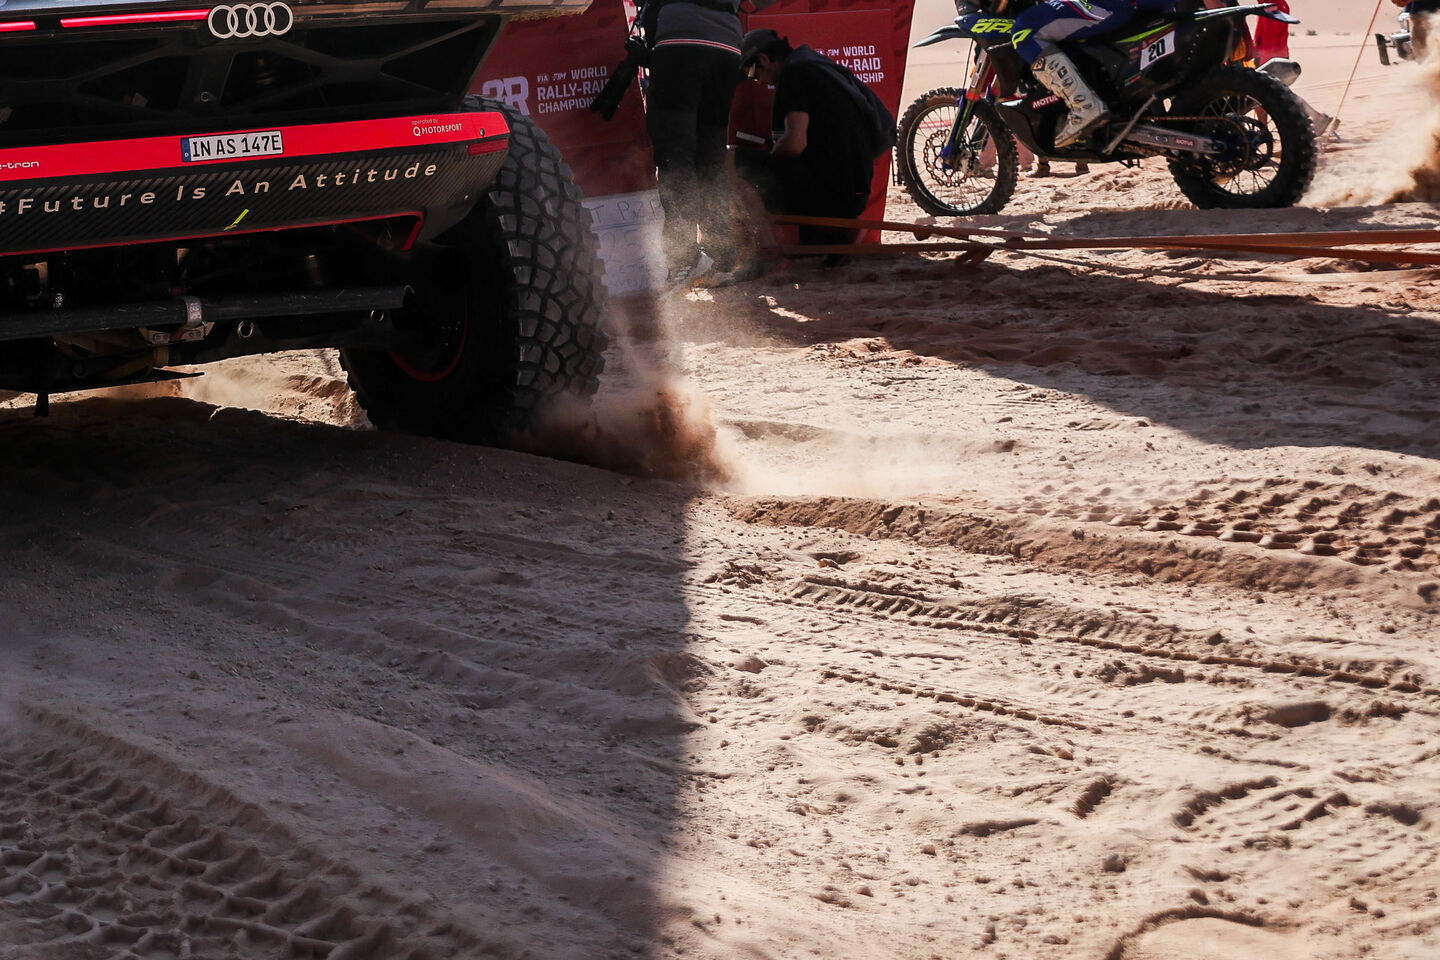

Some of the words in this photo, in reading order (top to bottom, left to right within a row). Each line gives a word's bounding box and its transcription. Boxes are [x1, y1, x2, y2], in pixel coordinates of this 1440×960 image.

[843, 45, 875, 57] WORLD
[1148, 38, 1166, 62] 20
[571, 65, 608, 81] WORLD
[537, 78, 610, 101] RALLY-RAI
[1032, 95, 1058, 109] MOTUL
[422, 123, 462, 134] MOTORSPORT
[192, 140, 211, 158] IN
[216, 138, 236, 155] AS
[241, 134, 281, 153] 147E
[176, 185, 206, 201] Is
[225, 179, 270, 197] An
[288, 162, 437, 190] Attitude
